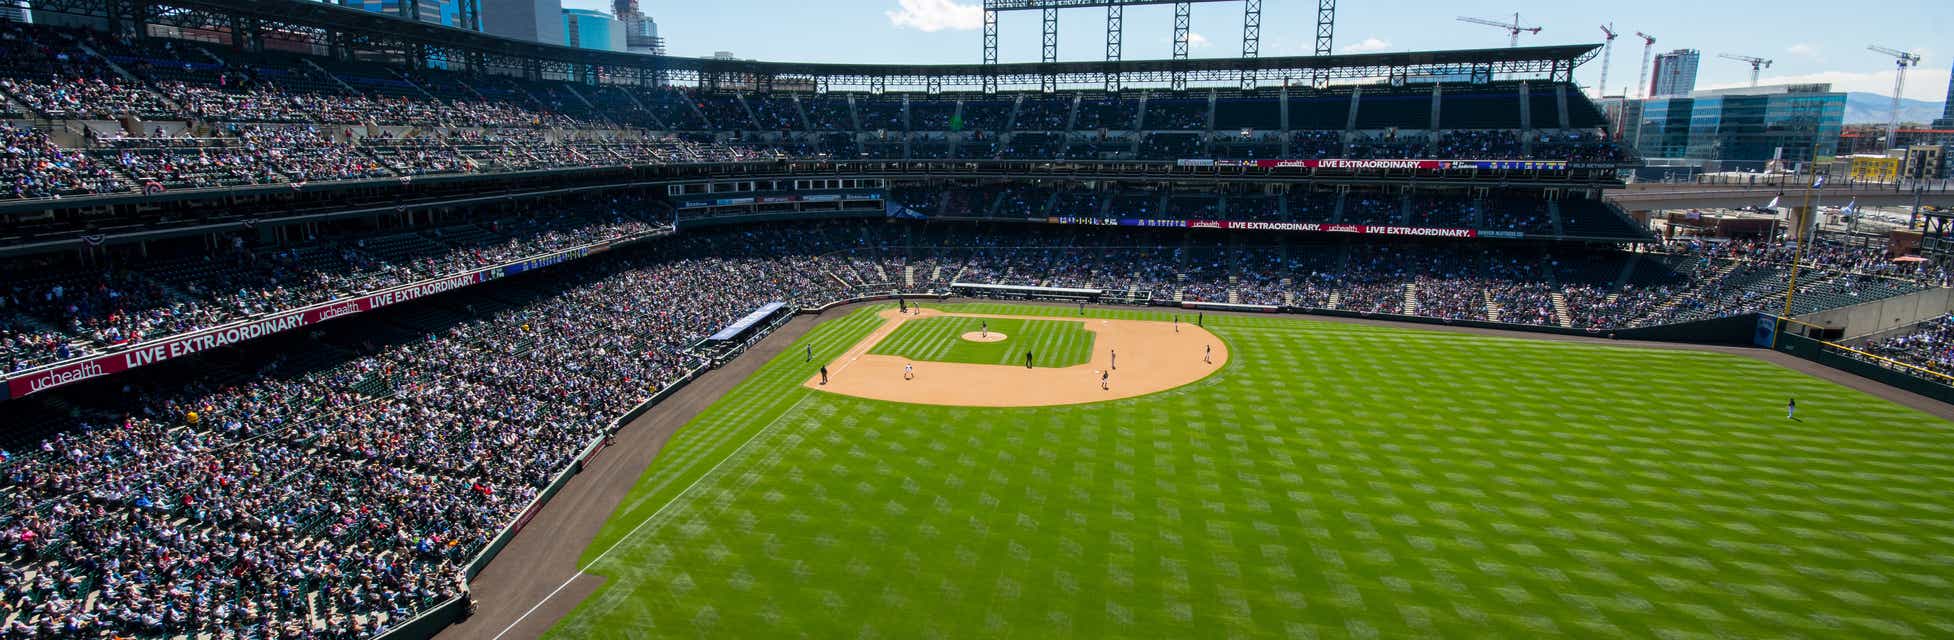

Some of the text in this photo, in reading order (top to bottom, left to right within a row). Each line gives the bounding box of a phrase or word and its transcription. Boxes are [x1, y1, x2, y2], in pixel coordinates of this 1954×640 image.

[1277, 160, 1305, 168] uchealth
[1318, 160, 1422, 169] LIVE EXTRAORDINARY.
[1247, 221, 1321, 231] EXTRAORDINARY.
[1328, 224, 1358, 233] uchealth
[1366, 226, 1385, 234] LIVE
[1387, 226, 1470, 237] EXTRAORDINARY.
[369, 275, 476, 309] LIVE EXTRAORDINARY.
[319, 301, 360, 321] uchealth
[125, 313, 308, 369] LIVE EXTRAORDINARY.
[30, 360, 103, 392] uchealth
